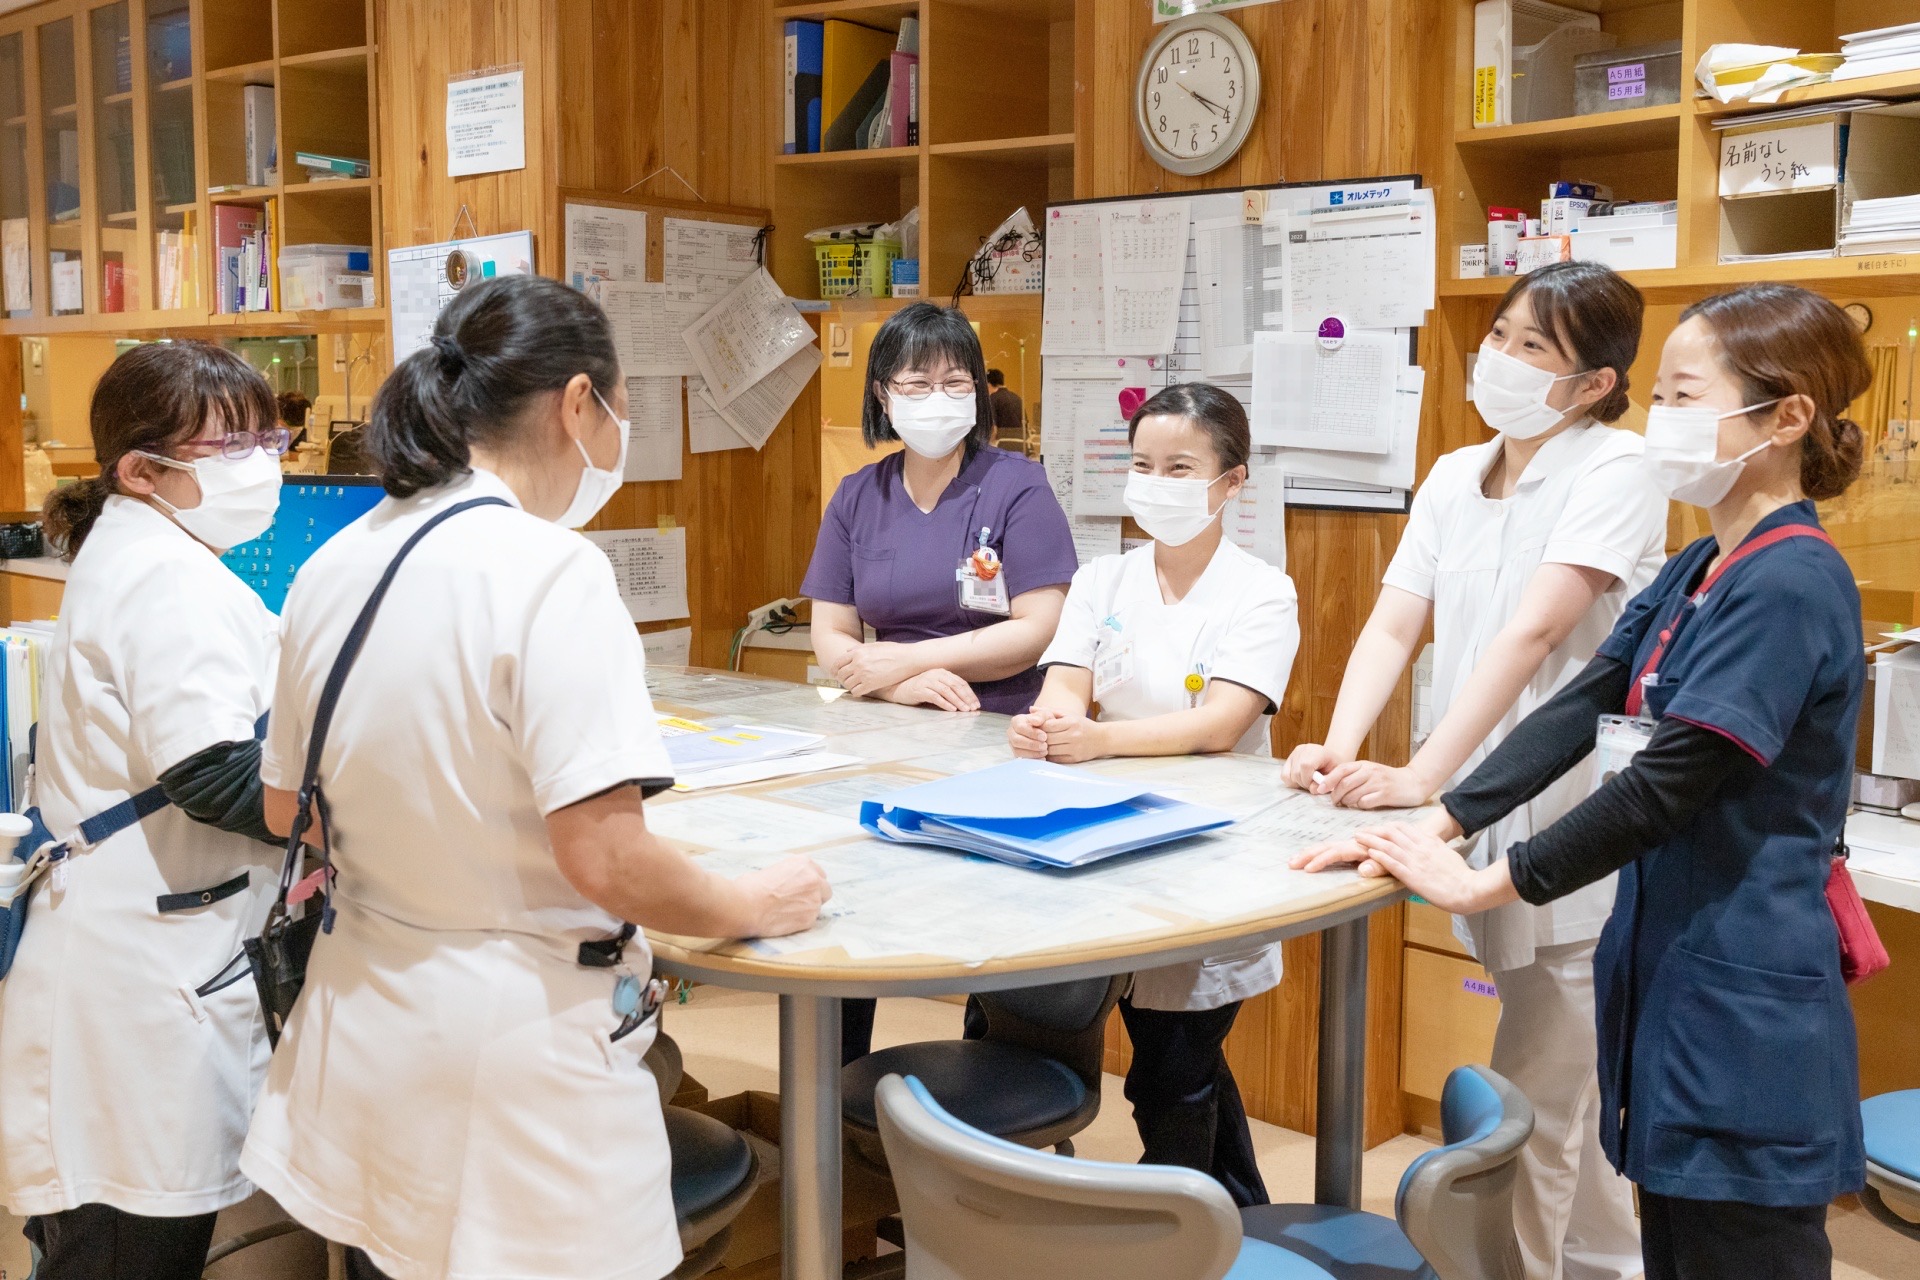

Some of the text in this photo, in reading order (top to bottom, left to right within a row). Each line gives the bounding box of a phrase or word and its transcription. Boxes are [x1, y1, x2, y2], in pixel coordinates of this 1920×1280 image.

[1188, 38, 1199, 56] 12
[1210, 41, 1215, 58] 1
[1171, 47, 1181, 65] 11
[1223, 57, 1230, 74] 2
[1610, 66, 1643, 79] A5用紙
[1157, 67, 1168, 84] 10
[1229, 80, 1235, 99] 3
[1610, 84, 1643, 97] B5用紙
[1154, 92, 1161, 110] 9
[1223, 105, 1230, 123] 4
[1160, 115, 1167, 132] 8
[1173, 130, 1179, 148] 7
[1211, 124, 1218, 142] 5
[1191, 133, 1198, 151] 6
[1725, 140, 1787, 167] 名前なし
[1762, 161, 1810, 182] うら紙
[1347, 188, 1391, 201] オルメテック
[1569, 200, 1588, 209] EPSON
[832, 326, 847, 347] D
[1169, 359, 1177, 367] 24
[1169, 375, 1177, 384] 25
[1464, 980, 1495, 995] A4用紙
